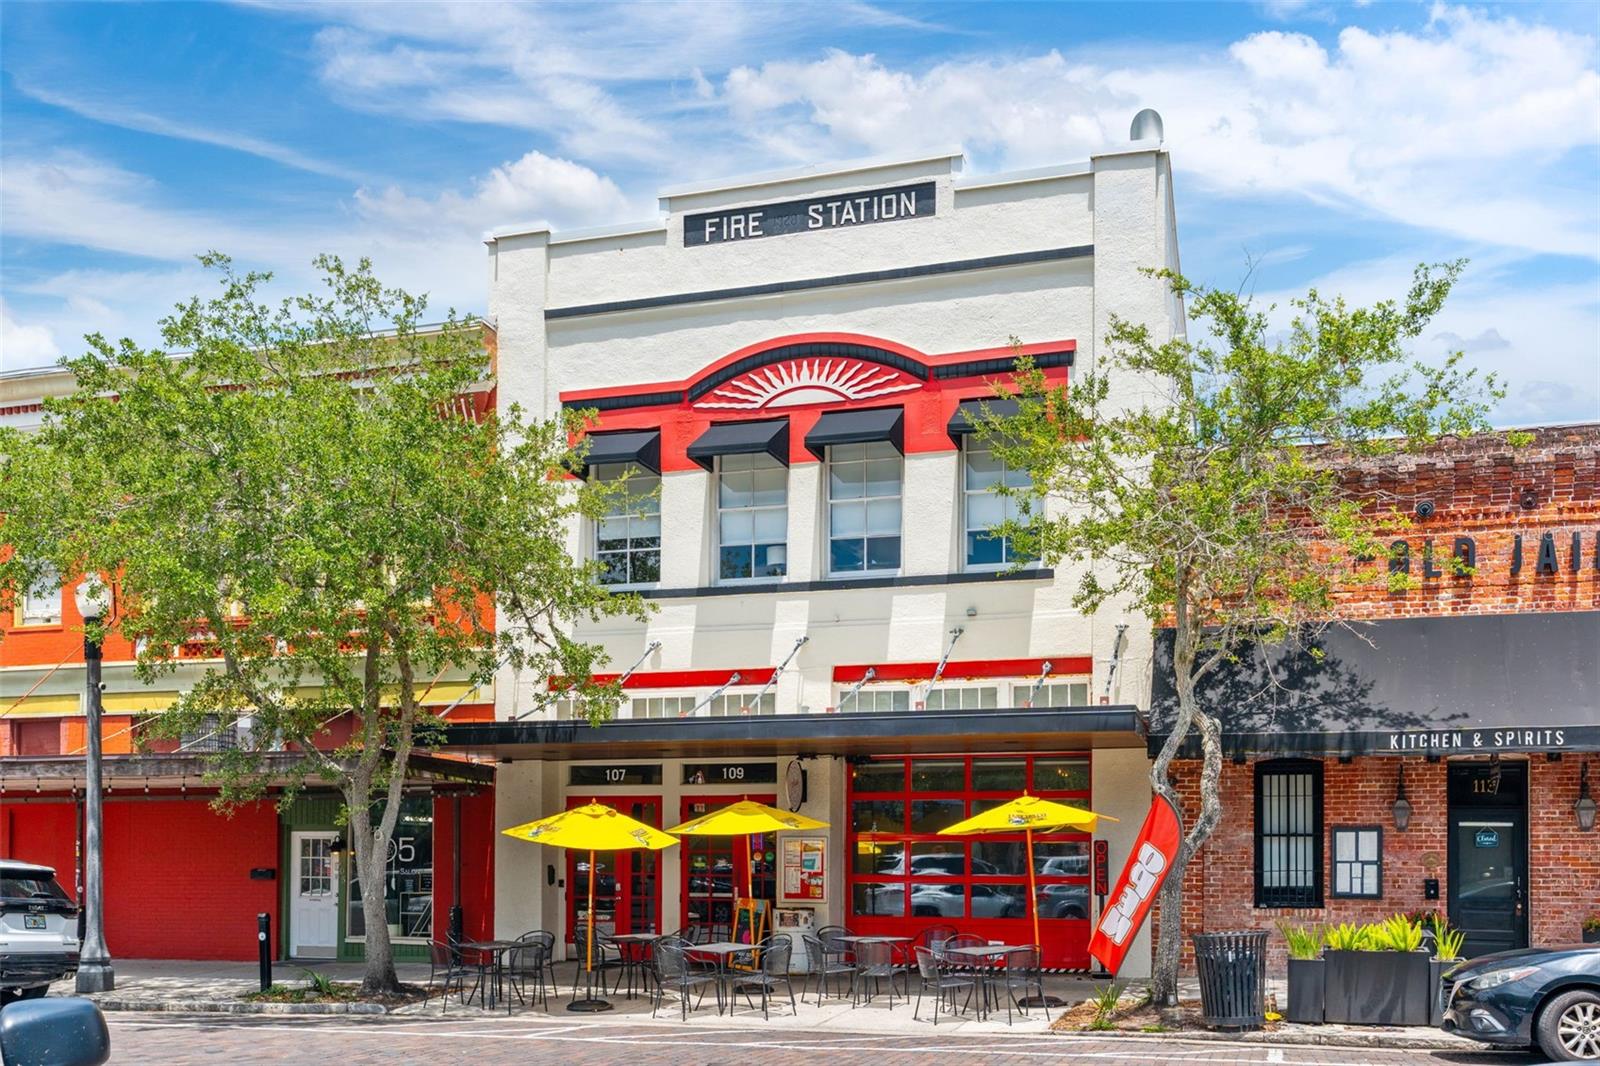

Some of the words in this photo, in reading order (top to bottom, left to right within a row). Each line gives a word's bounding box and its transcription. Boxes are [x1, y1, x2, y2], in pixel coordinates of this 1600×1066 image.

[705, 212, 763, 242] FIRE
[808, 191, 916, 229] STATION
[1389, 537, 1476, 579] OLD
[1510, 531, 1600, 576] JAI
[1390, 733, 1462, 750] KITCHEN
[1473, 732, 1483, 747] &
[1494, 730, 1565, 747] SPIRITS
[605, 768, 626, 781] 107
[722, 767, 744, 780] 109
[1096, 841, 1107, 894] OPEN
